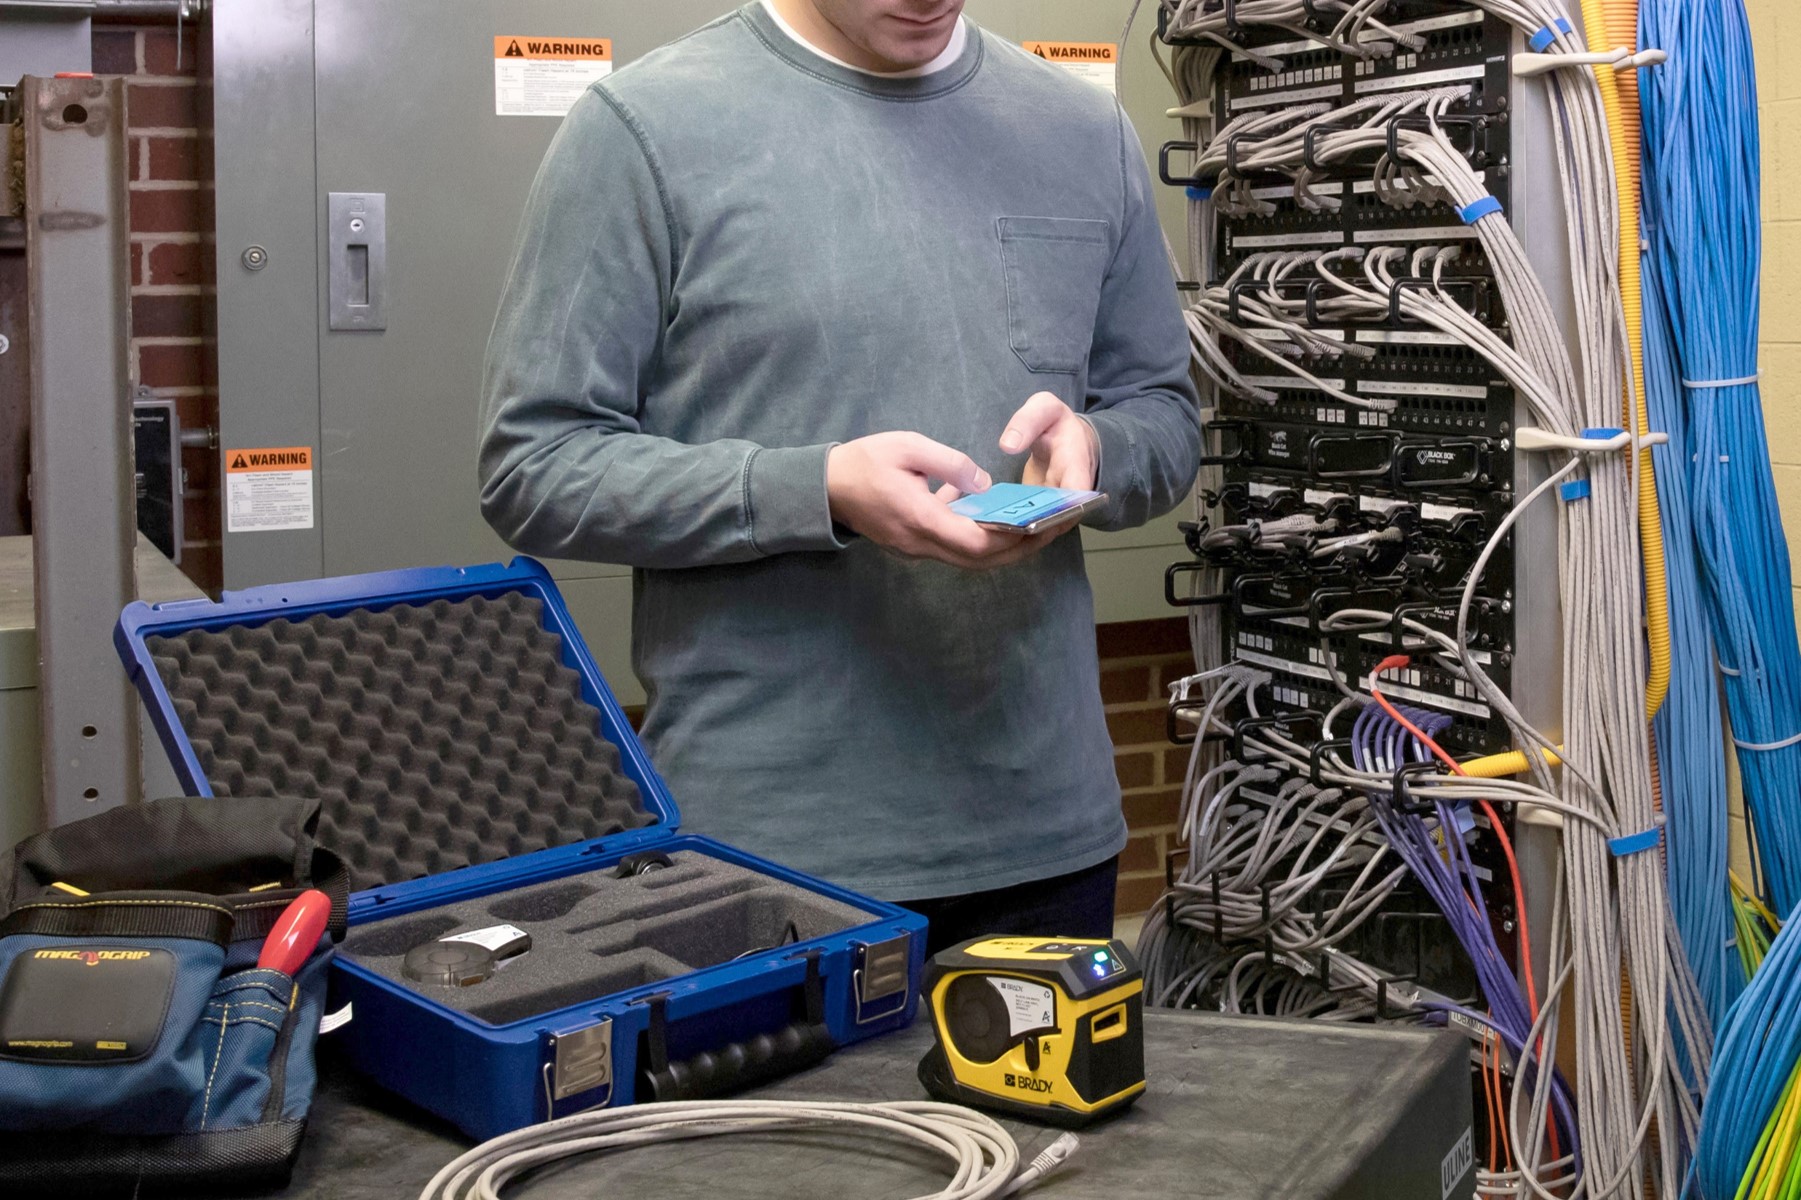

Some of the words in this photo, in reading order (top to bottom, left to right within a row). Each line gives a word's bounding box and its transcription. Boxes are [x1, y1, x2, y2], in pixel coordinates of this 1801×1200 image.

[527, 42, 604, 55] WARNING
[1049, 47, 1111, 58] WARNING
[249, 452, 307, 466] WARNING
[1428, 450, 1443, 459] BLACK
[1443, 452, 1455, 460] BOX
[1007, 983, 1023, 993] BRADY
[1018, 1075, 1053, 1094] BRADY
[1443, 1135, 1471, 1191] ULINE
